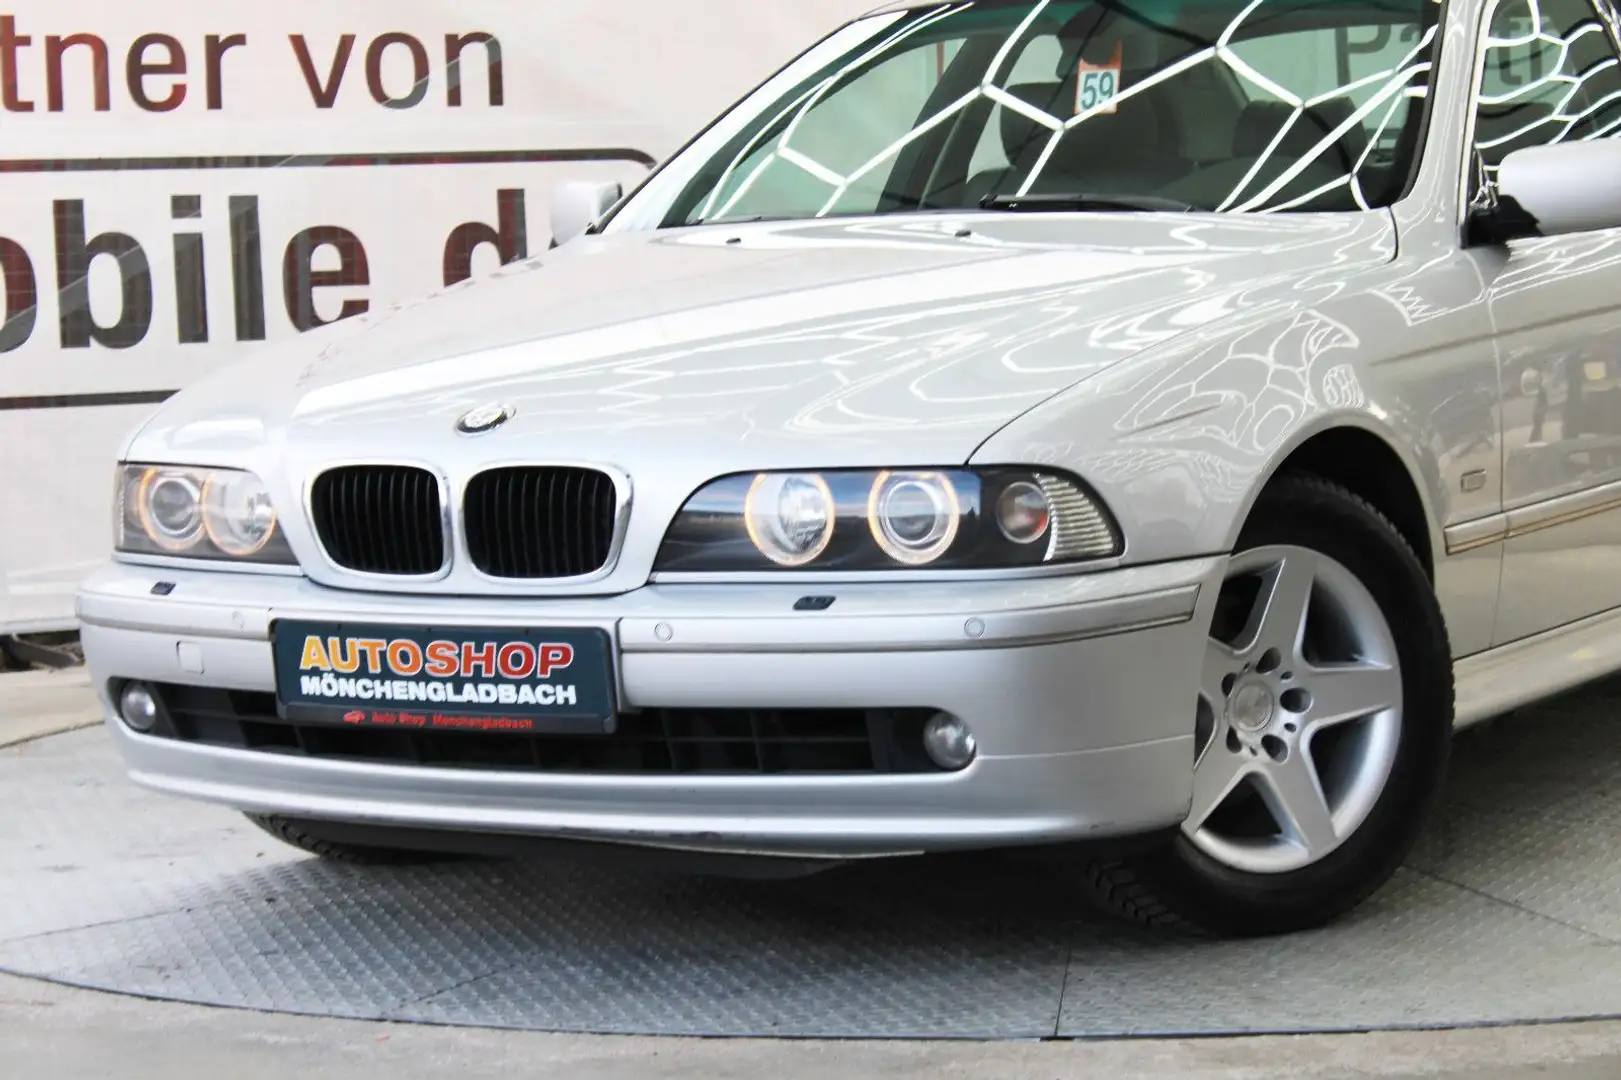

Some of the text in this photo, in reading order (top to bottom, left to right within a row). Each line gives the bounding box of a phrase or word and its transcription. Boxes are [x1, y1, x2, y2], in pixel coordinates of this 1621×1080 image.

[288, 30, 504, 110] von
[1081, 71, 1115, 110] 59
[299, 634, 575, 680] AUTOSHOP
[299, 672, 578, 706] MÖNCHENGLADBACH
